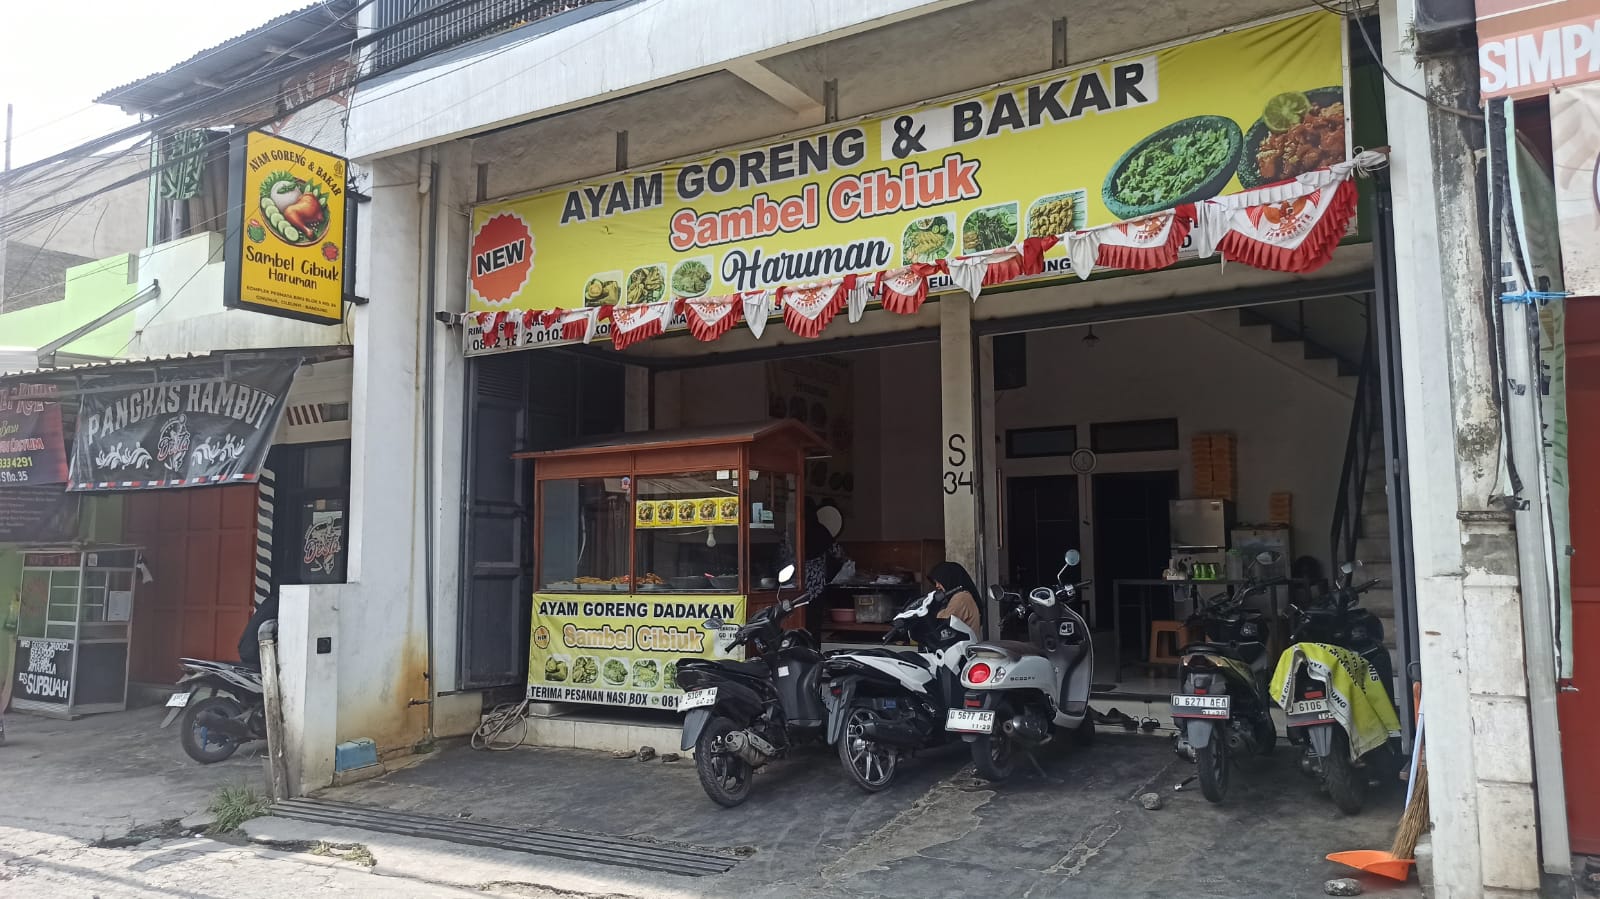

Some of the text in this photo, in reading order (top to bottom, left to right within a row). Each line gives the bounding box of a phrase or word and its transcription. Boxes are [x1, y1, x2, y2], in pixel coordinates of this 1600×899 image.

[560, 63, 1148, 225] AYAM GORENG & BAKAR
[249, 150, 342, 196] AYAM GORENG & BAKAR
[669, 152, 981, 252] Sambel Cibiuk
[246, 245, 339, 281] Sambel Cibiuk
[476, 240, 525, 276] NEW
[721, 240, 892, 291] Haruman
[268, 267, 318, 290] Haruman
[88, 382, 181, 445] PANGKAS
[187, 382, 278, 430] RAMBUT
[948, 433, 966, 467] S
[943, 471, 973, 495] 34
[539, 601, 735, 619] AYAM GORENG DADAKAN
[562, 623, 705, 652] Sambel Cibiuk
[530, 686, 562, 699] TERIMA
[564, 690, 602, 702] PESANAN
[606, 692, 627, 703] NASI
[629, 693, 649, 706] BOX
[1174, 697, 1180, 706] D
[1185, 697, 1206, 706] 6271
[1299, 701, 1322, 712] 6106
[958, 711, 976, 720] 5677
